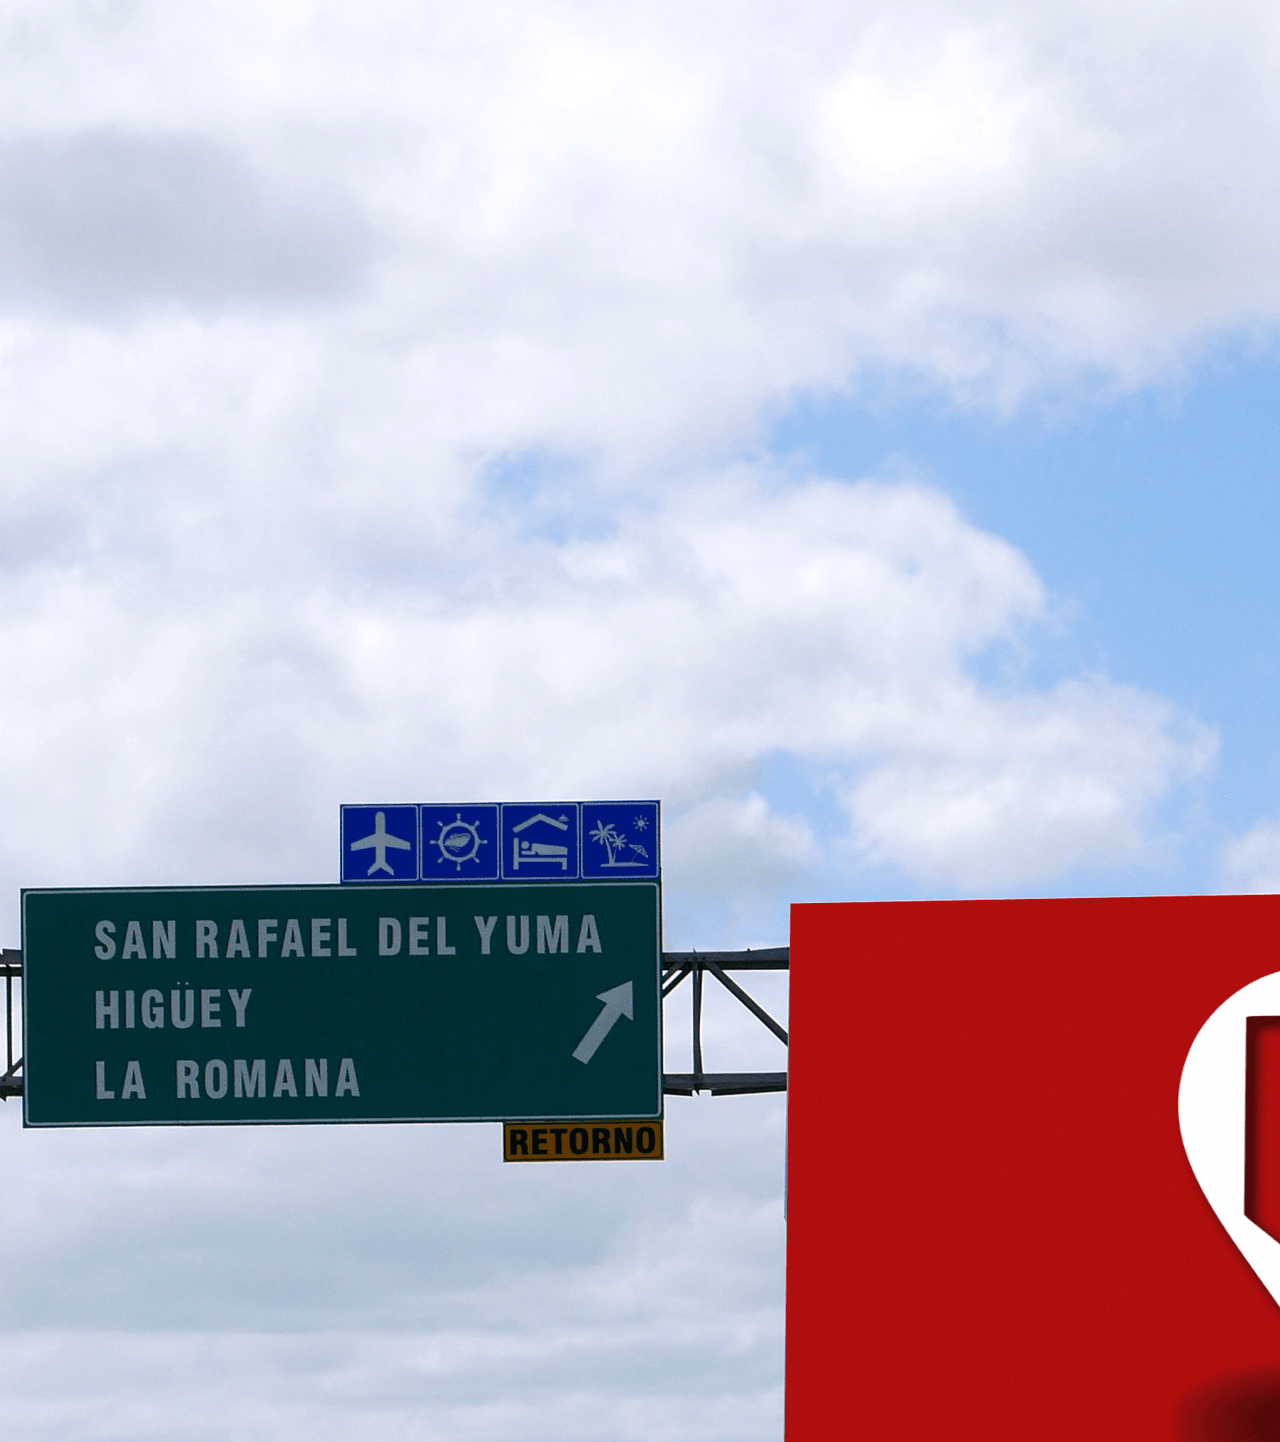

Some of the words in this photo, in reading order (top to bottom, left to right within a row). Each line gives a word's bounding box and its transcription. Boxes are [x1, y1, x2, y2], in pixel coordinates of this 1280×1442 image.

[95, 921, 175, 960] SAN
[195, 919, 357, 959] RAFAEL
[379, 917, 456, 956] DEL
[473, 915, 602, 955] YUMA
[95, 981, 252, 1029] HIGÜEY
[96, 1060, 147, 1100] LA
[177, 1058, 360, 1099] ROMANA
[509, 1126, 657, 1156] RETORNO
